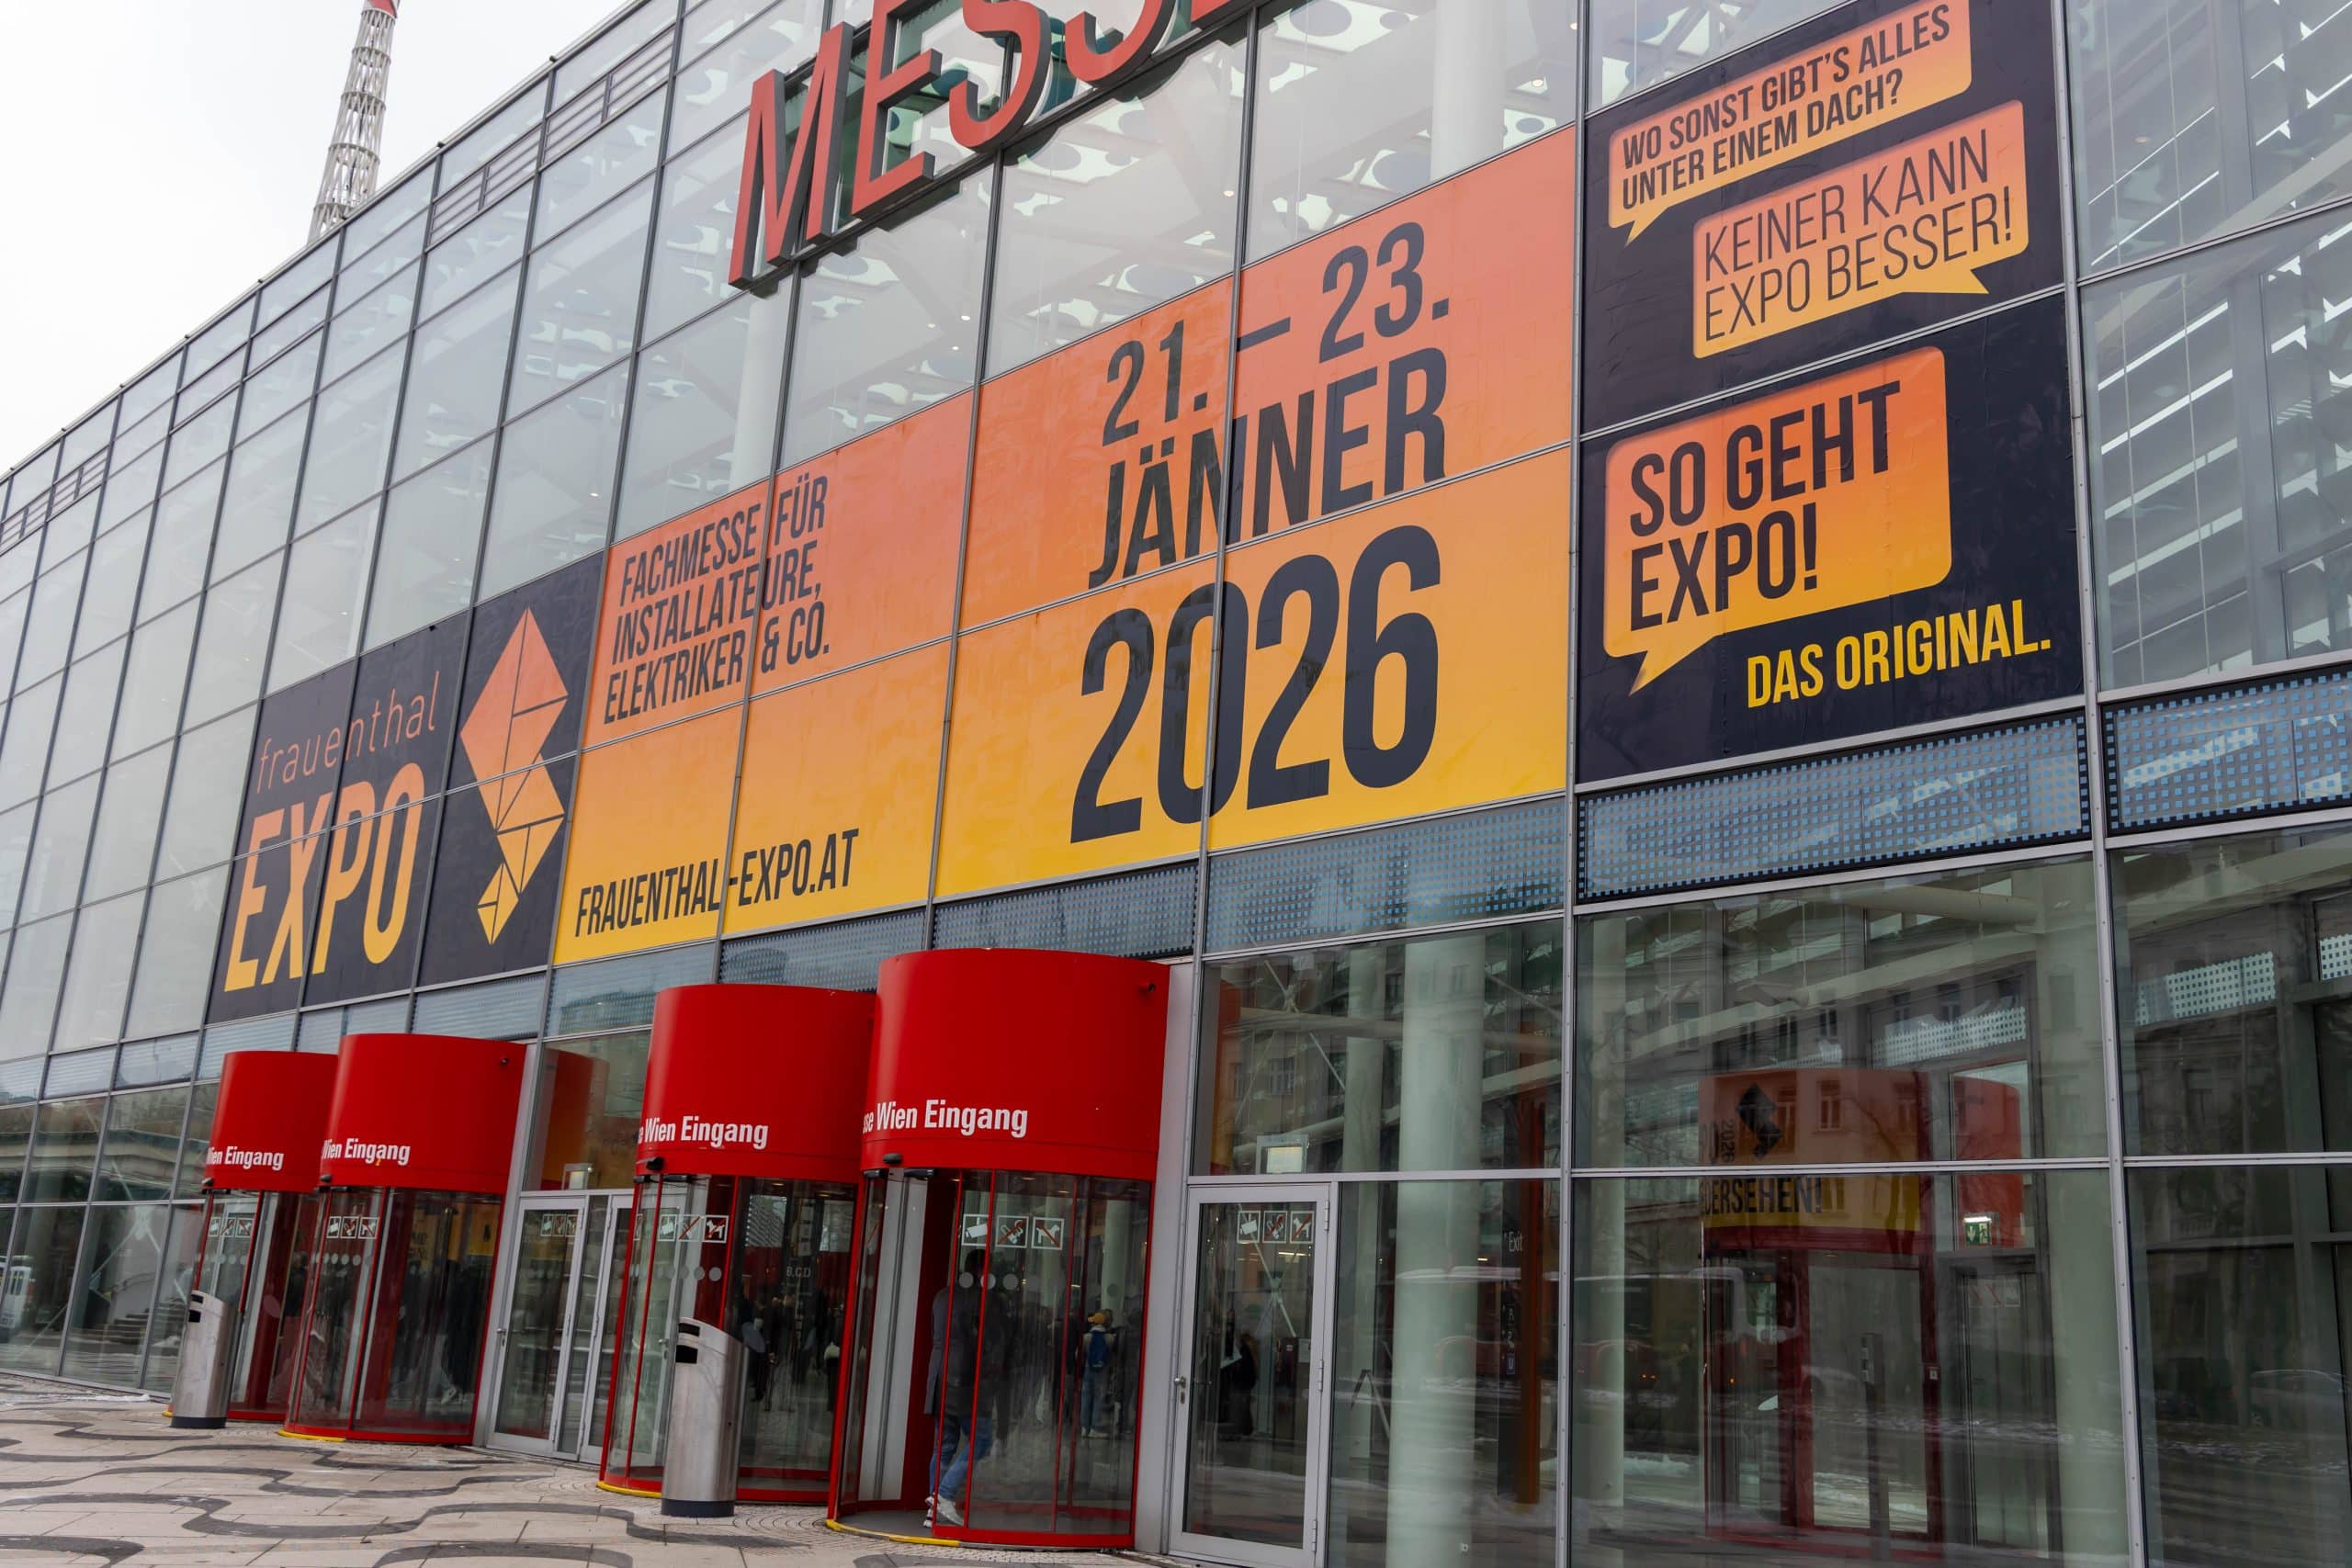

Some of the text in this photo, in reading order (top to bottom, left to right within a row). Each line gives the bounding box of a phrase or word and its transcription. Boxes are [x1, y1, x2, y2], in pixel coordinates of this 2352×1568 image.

[727, 0, 1236, 288] MES
[1623, 4, 1951, 169] WO SONST GIBT'S ALLES
[1623, 68, 1904, 210] UNTER EINEM DACH?
[1705, 129, 1989, 282] KEINER KANN
[1705, 186, 2013, 341] EXPO BESSER!
[1102, 320, 1207, 446] 21.
[1319, 221, 1449, 363] 23.
[1089, 347, 1447, 589] JÄNNER
[1630, 380, 1901, 537] SO GEHT
[612, 539, 821, 666] INSTALLATEURE,
[620, 473, 828, 607] FACHMESSE FÜR
[1630, 502, 1817, 631] EXPO!
[604, 600, 830, 724] ELEKTRIKER & CO.
[1070, 525, 1441, 843] 2026
[1747, 599, 2051, 708] DAS ORIGINAL.
[256, 671, 440, 795] frauenthal
[224, 762, 425, 992] EXPO
[575, 828, 859, 937] FRAUENTHAL-EXPO.AT
[224, 1146, 284, 1171] Eingang
[345, 1138, 411, 1166] Eingang
[644, 1117, 676, 1143] Wien
[681, 1115, 768, 1150] Eingang
[876, 1100, 918, 1131] Wien
[924, 1100, 1028, 1138] Eingang
[1509, 1230, 1523, 1252] Exit
